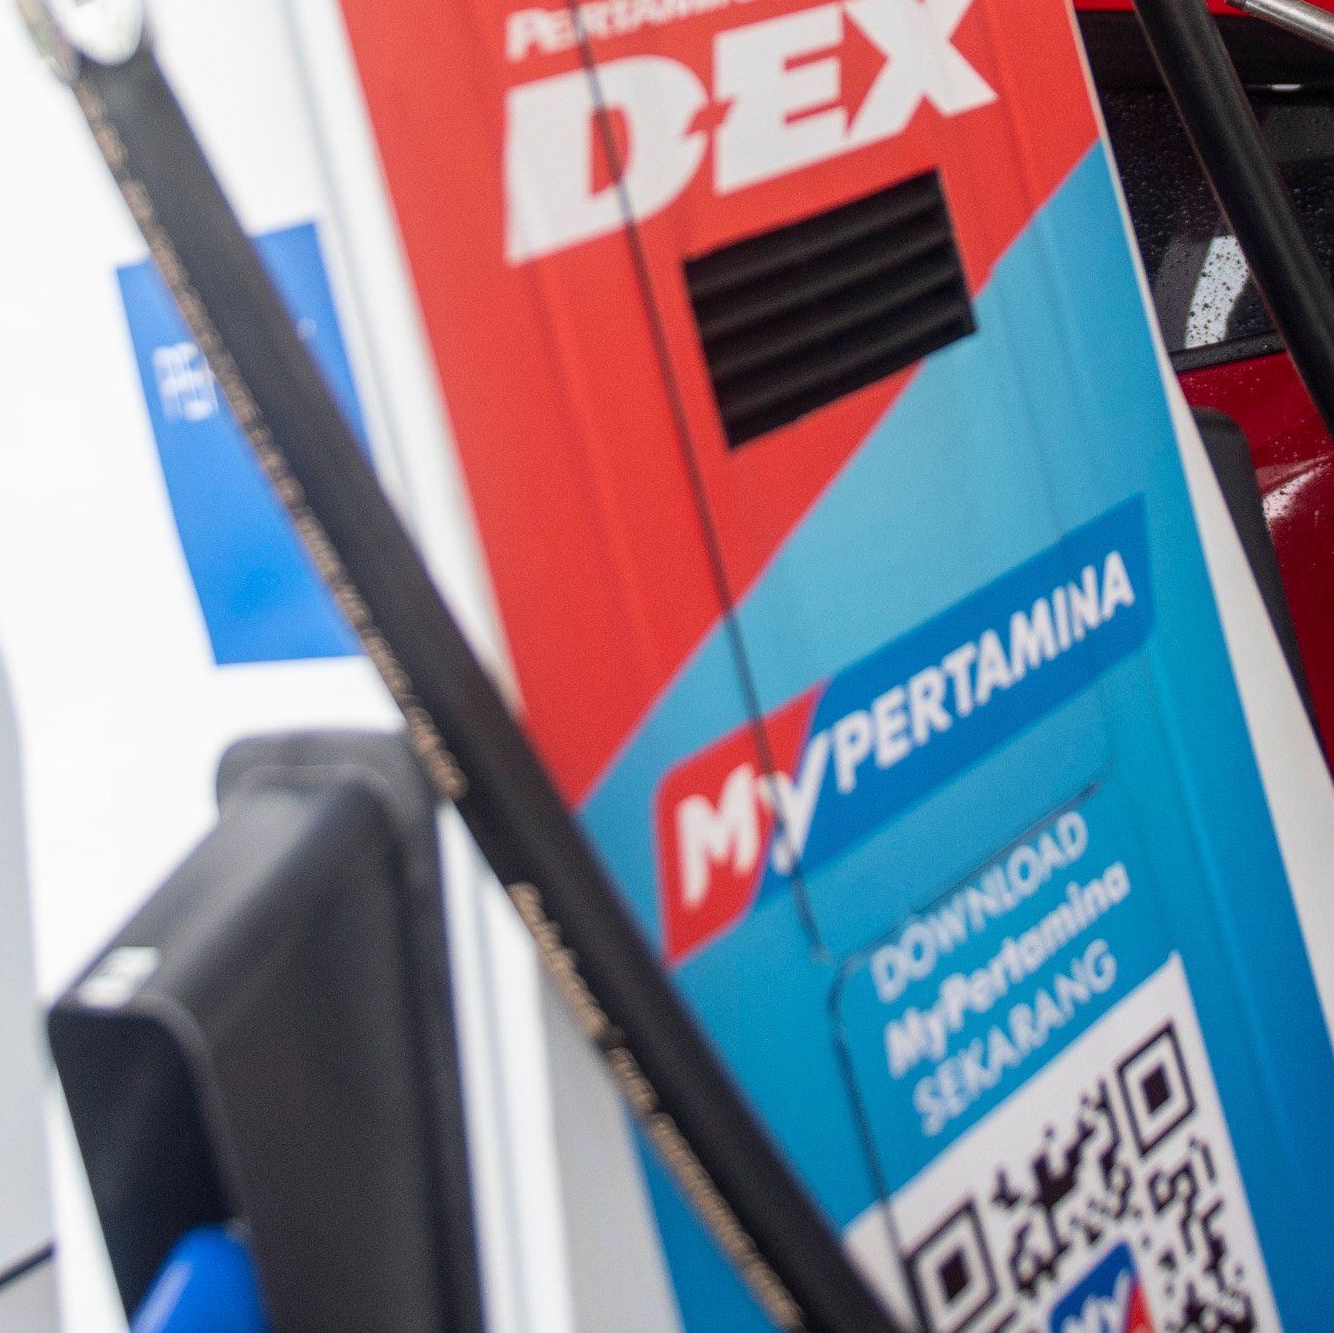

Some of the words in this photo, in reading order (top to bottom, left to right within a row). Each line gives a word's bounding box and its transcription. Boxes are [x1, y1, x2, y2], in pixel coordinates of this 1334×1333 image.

[871, 810, 1088, 1003] DOWNLOAD
[882, 862, 1131, 1079] MyPertamina
[912, 939, 1119, 1138] SEKARANG
